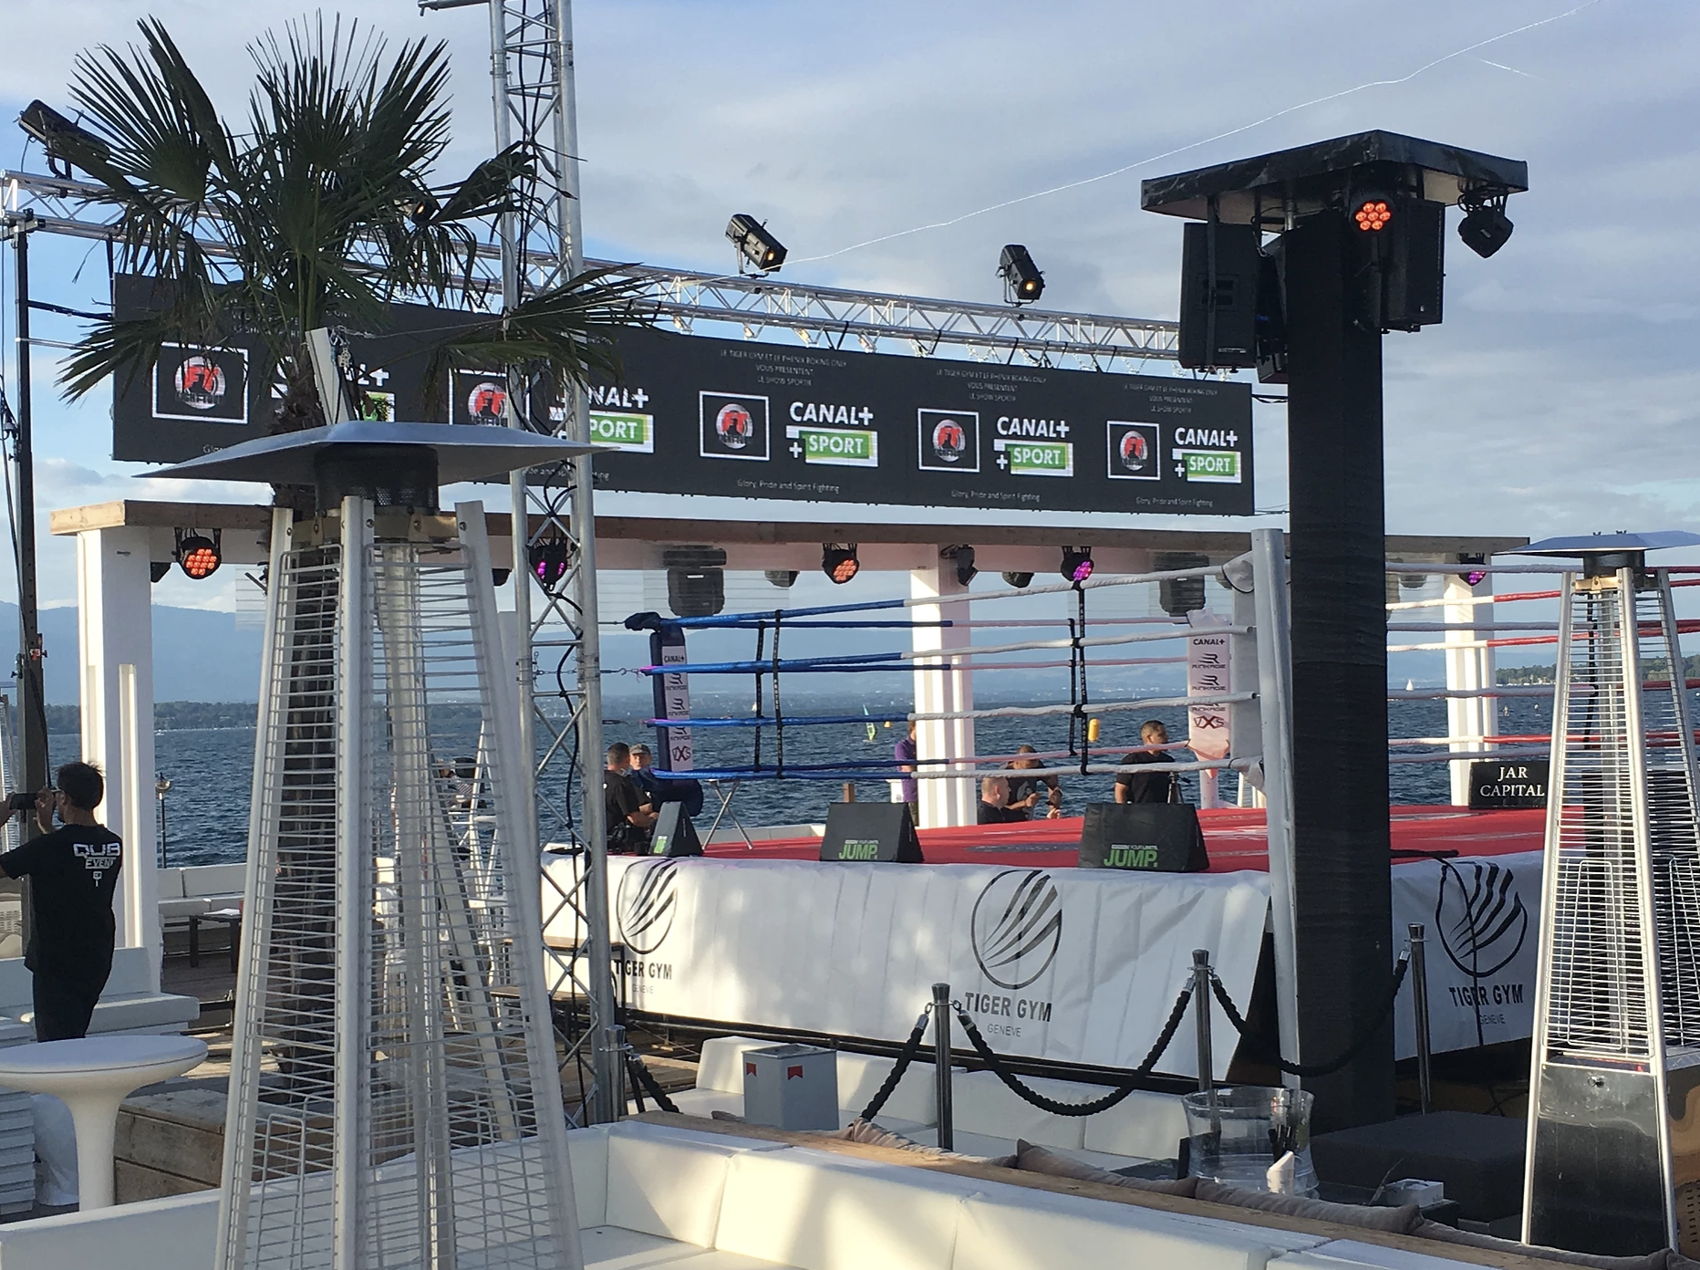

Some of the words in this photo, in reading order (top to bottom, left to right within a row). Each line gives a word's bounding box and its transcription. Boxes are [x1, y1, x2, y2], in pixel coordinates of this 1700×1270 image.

[583, 385, 649, 409] NAL+
[789, 401, 874, 426] CANAL+
[589, 419, 638, 440] PORT
[997, 416, 1070, 438] CANAL+
[1174, 427, 1238, 447] CANAL+
[808, 434, 864, 454] SPORT
[1013, 447, 1061, 465] SPORT
[1189, 456, 1231, 472] SPORT
[779, 481, 792, 489] and
[1193, 638, 1225, 646] CANAL+
[1497, 766, 1528, 782] JAR
[1480, 784, 1545, 797] CAPITAL
[648, 962, 672, 980] GYM
[1493, 984, 1524, 1005] GYM
[965, 992, 1011, 1017] TIGER
[1017, 999, 1052, 1022] GYM
